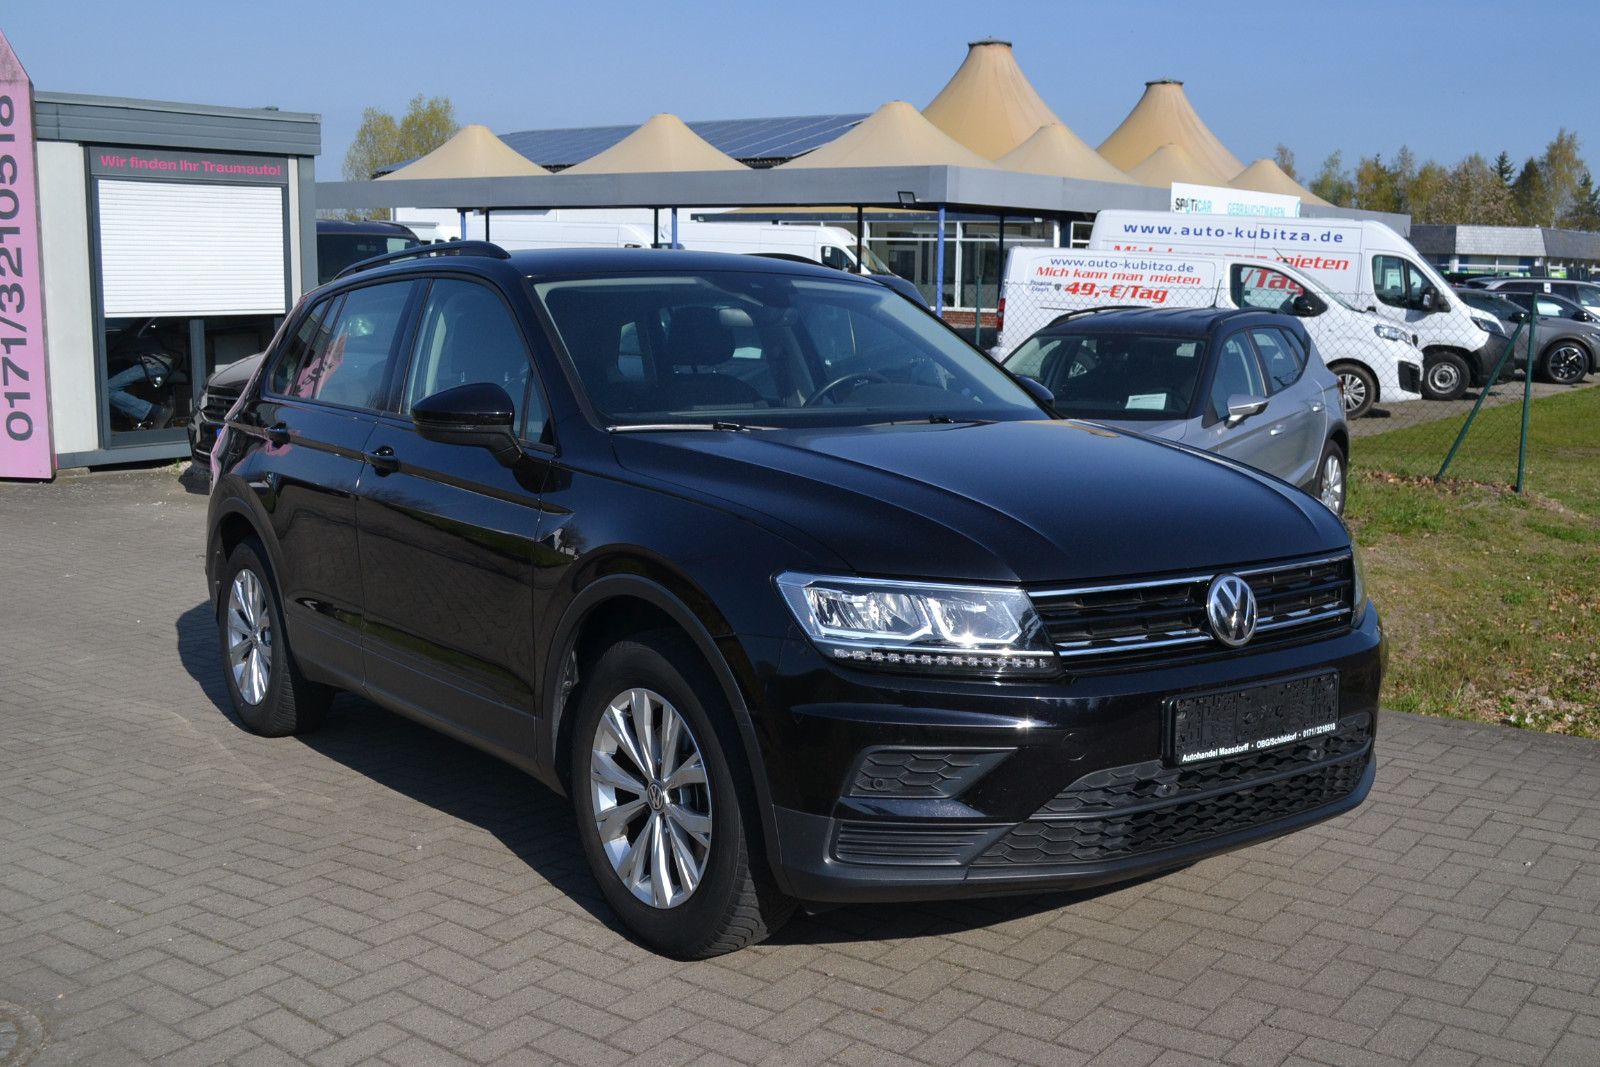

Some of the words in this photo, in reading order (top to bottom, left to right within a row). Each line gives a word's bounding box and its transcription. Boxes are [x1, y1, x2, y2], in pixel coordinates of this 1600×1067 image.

[100, 155, 126, 168] Wir
[130, 157, 177, 171] finden
[180, 160, 199, 172] Ihr
[201, 161, 281, 176] Traumauto!
[1123, 222, 1344, 243] www.auto-kubitza.de
[1050, 257, 1195, 273] www.auto-kubitza.de
[1036, 266, 1069, 278] Mich
[1073, 269, 1108, 280] kann
[1112, 273, 1144, 282] man
[1149, 274, 1201, 285] mieten
[1182, 748, 1218, 762] Autohandel
